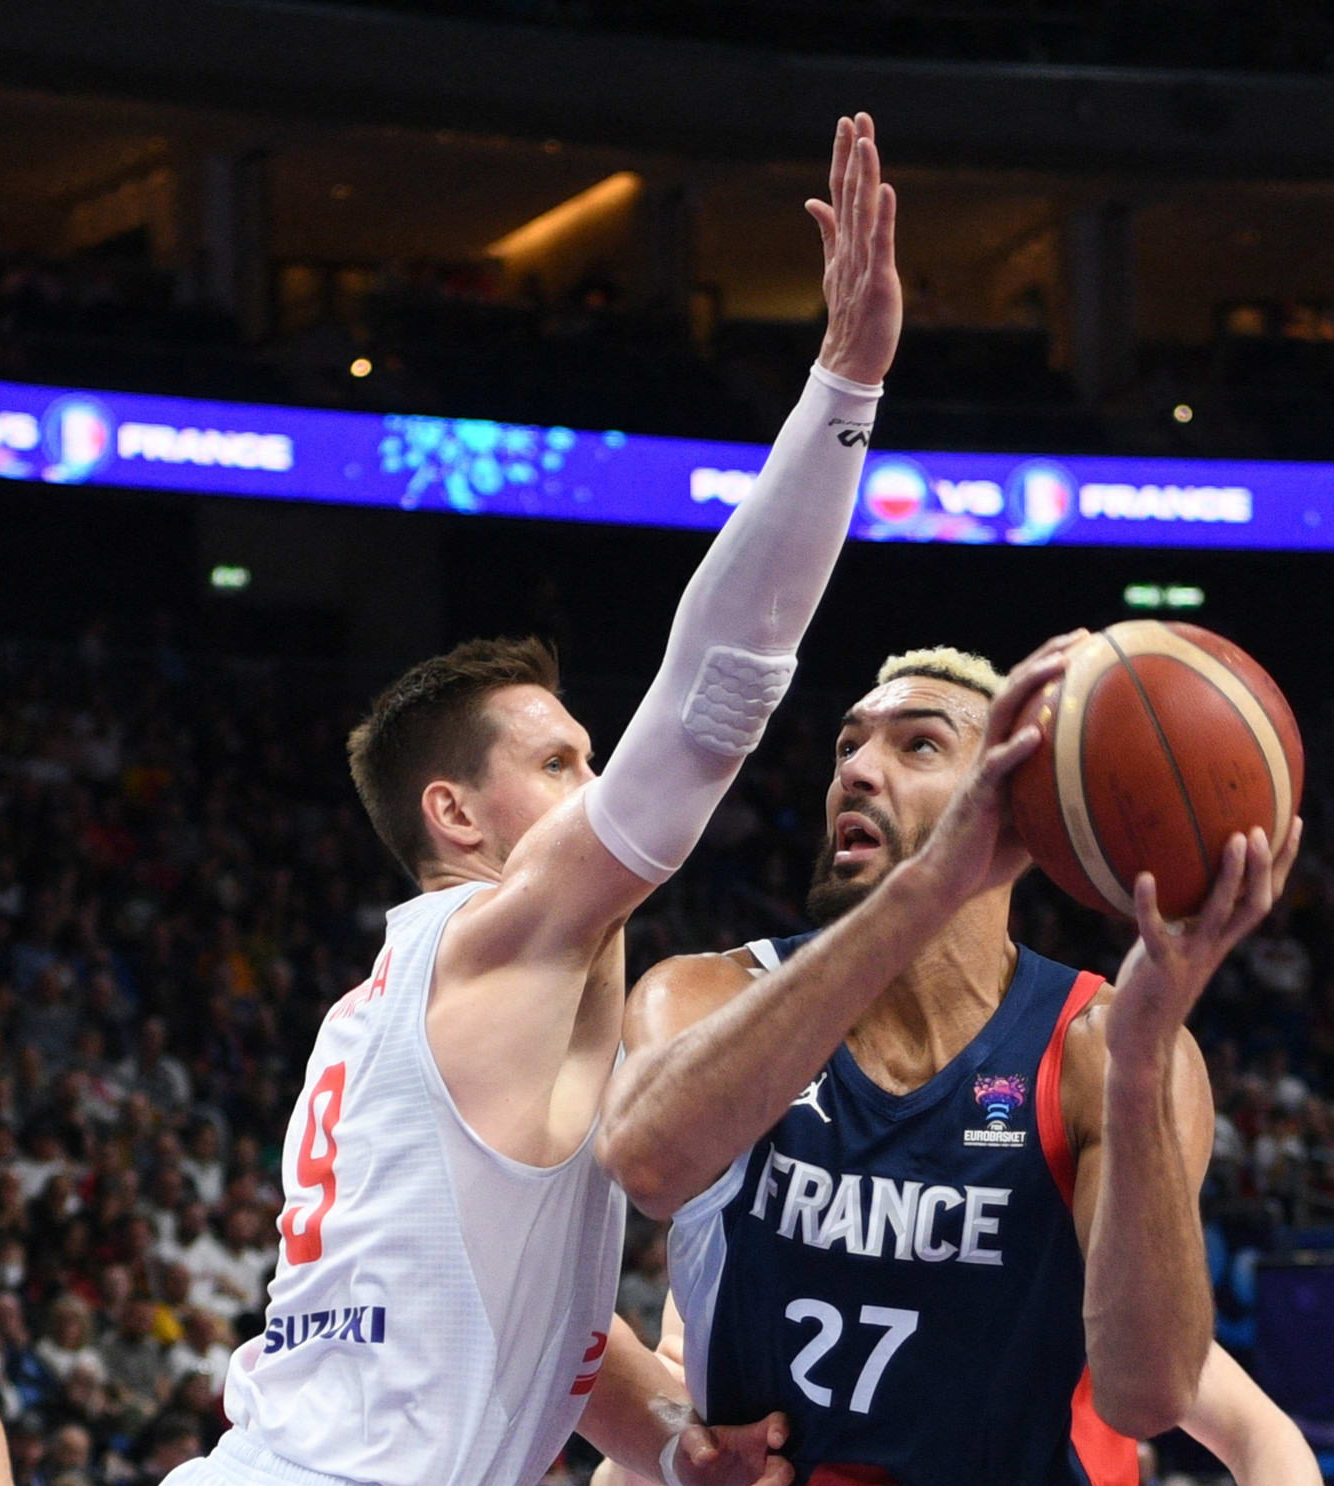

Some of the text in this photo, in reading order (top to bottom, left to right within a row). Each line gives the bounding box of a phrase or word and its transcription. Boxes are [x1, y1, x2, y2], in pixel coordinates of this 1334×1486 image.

[117, 421, 293, 472] FRANCE
[281, 1061, 346, 1265] 9
[964, 1130, 1026, 1142] EUROBASKET
[748, 1142, 1013, 1266] FRANCE
[263, 1305, 386, 1354] SUZUKI
[785, 1298, 919, 1414] 27
